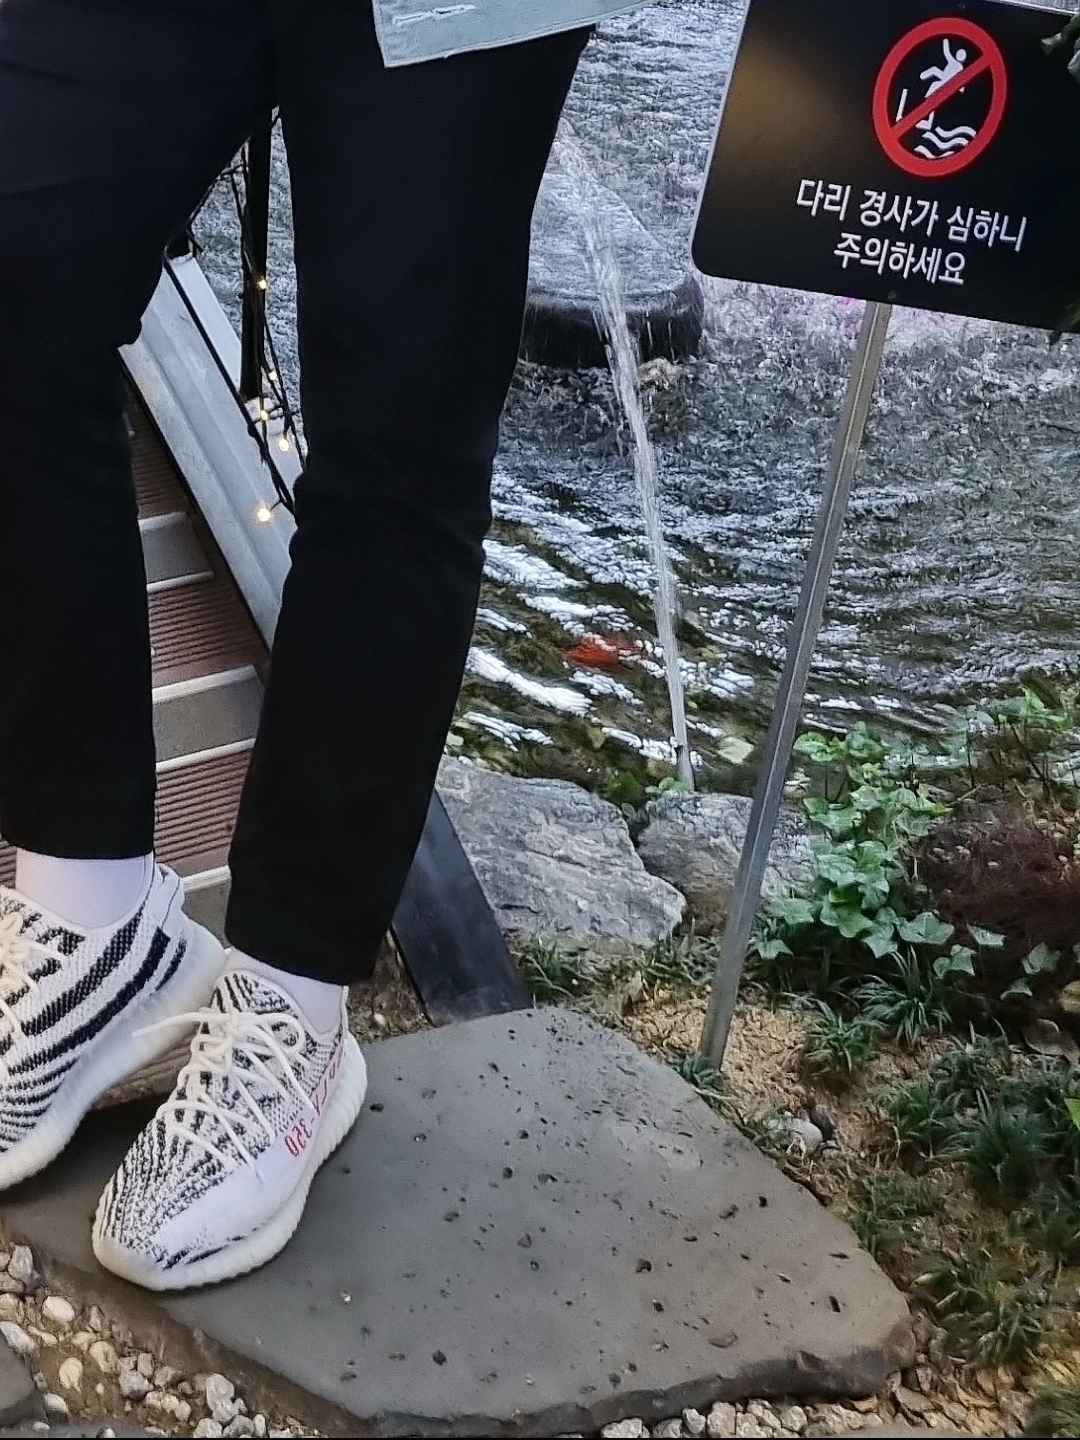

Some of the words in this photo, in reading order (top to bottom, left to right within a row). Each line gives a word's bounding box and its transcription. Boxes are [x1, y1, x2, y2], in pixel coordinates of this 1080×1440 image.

[796, 179, 851, 221] 다리
[860, 189, 938, 237] 경사가
[947, 205, 1027, 252] 심하니
[834, 232, 966, 285] 주의하세요
